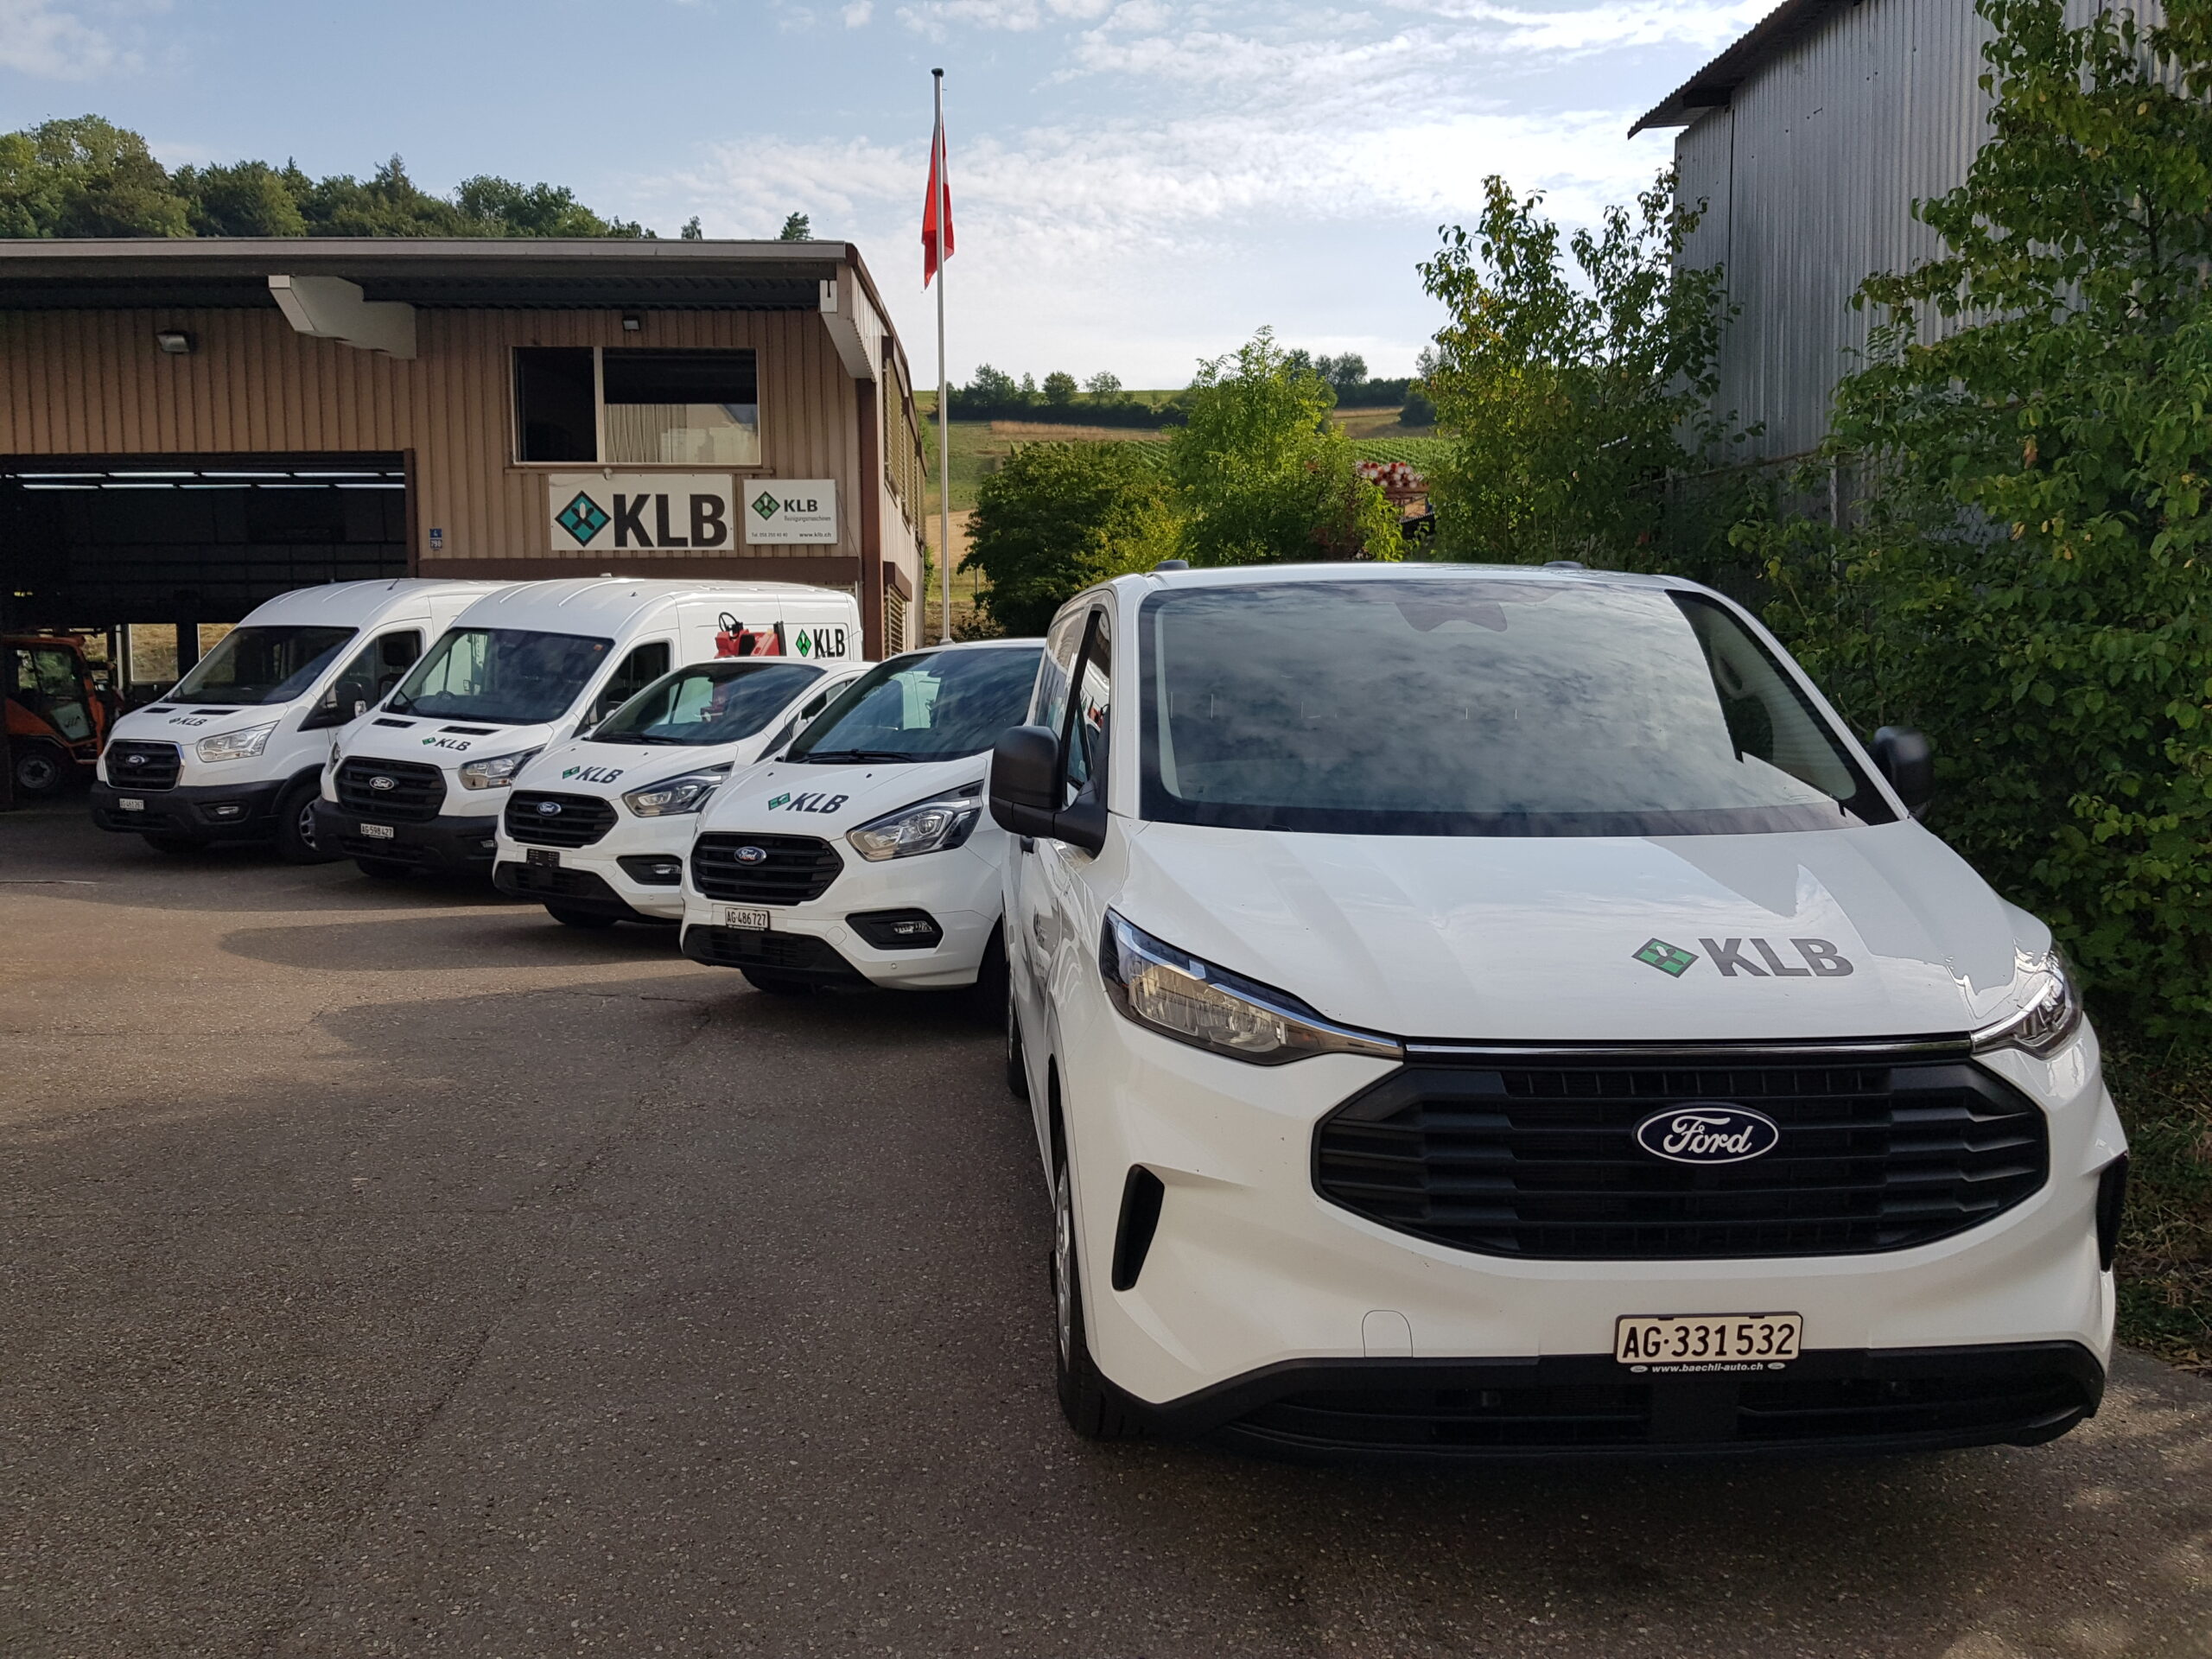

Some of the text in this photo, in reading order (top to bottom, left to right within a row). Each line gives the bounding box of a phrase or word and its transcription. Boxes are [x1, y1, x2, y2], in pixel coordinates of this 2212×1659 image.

[784, 499, 818, 512] KLB
[613, 493, 728, 548] KLB
[813, 628, 845, 658] KLB
[176, 717, 208, 727] KLB
[434, 738, 472, 751] KLB
[575, 766, 624, 784] KLB
[786, 792, 849, 814] KLB
[1698, 938, 1854, 976] KLB
[1662, 1116, 1754, 1154] Ford
[1651, 1363, 1764, 1373] www.baechli-auto.ch
